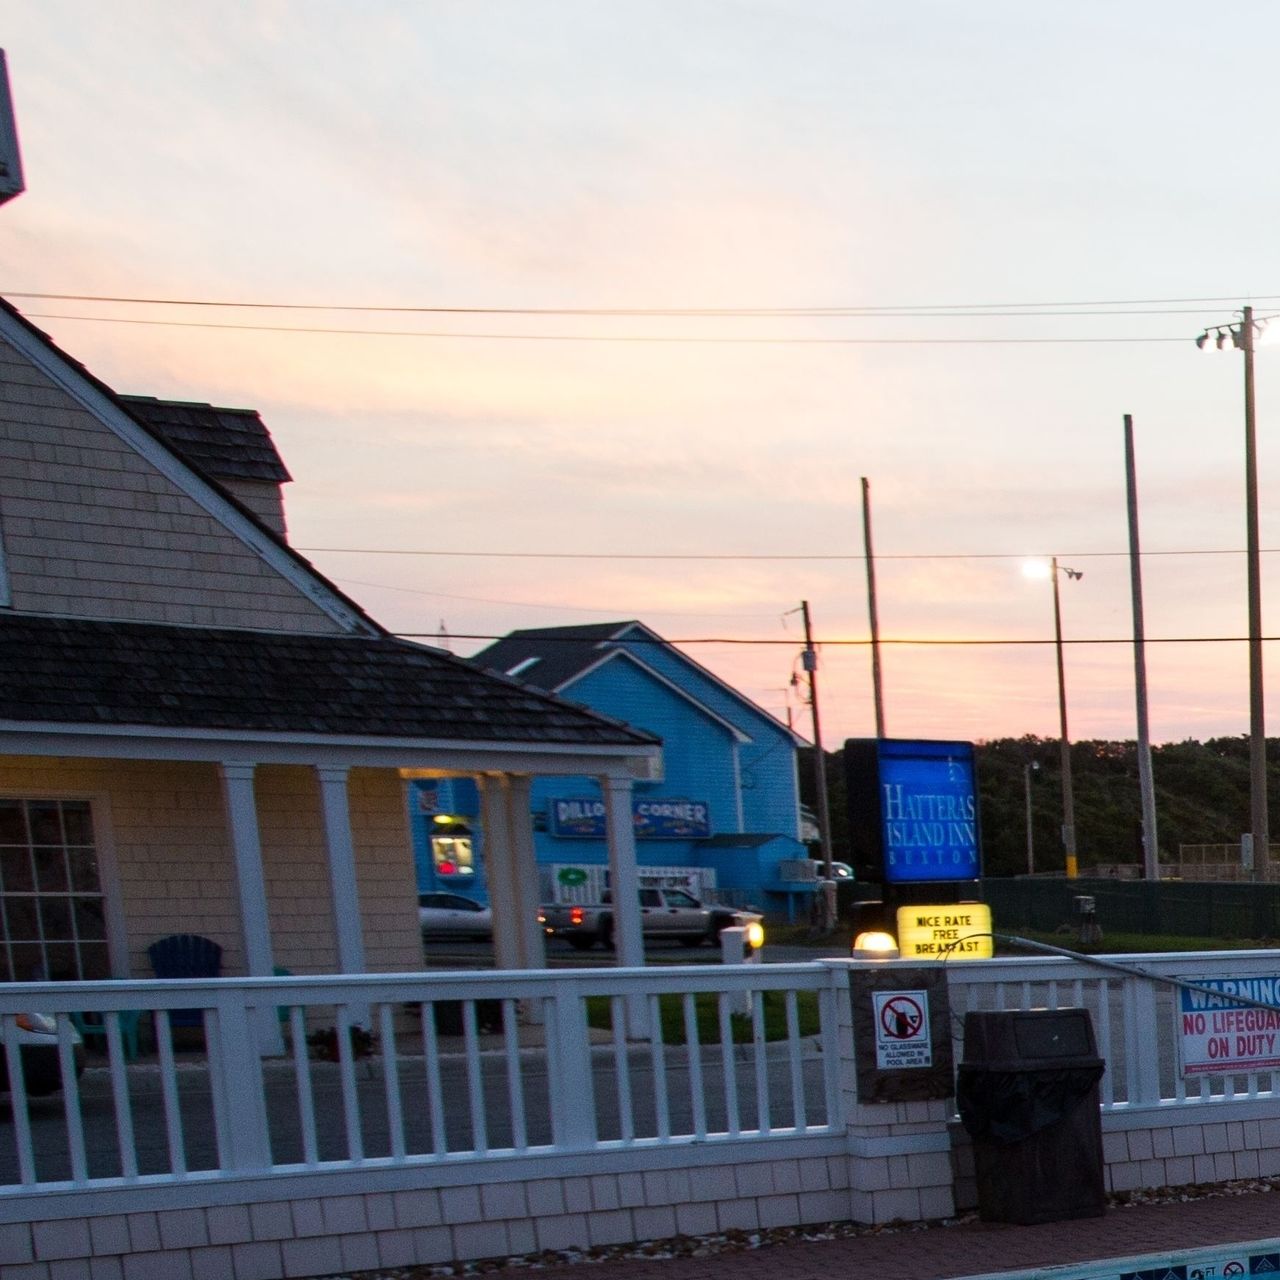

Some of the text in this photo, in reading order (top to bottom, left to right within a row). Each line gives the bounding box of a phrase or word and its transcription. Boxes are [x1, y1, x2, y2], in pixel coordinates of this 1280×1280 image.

[883, 784, 975, 820] HATTERAS
[638, 803, 706, 824] CORNER
[886, 822, 975, 847] ISLAND INN
[888, 850, 977, 865] BUXTON
[916, 915, 971, 927] NICE RATE
[933, 929, 959, 940] FREE
[1183, 1013, 1206, 1036] NO
[1207, 1033, 1276, 1059] ON DUTY
